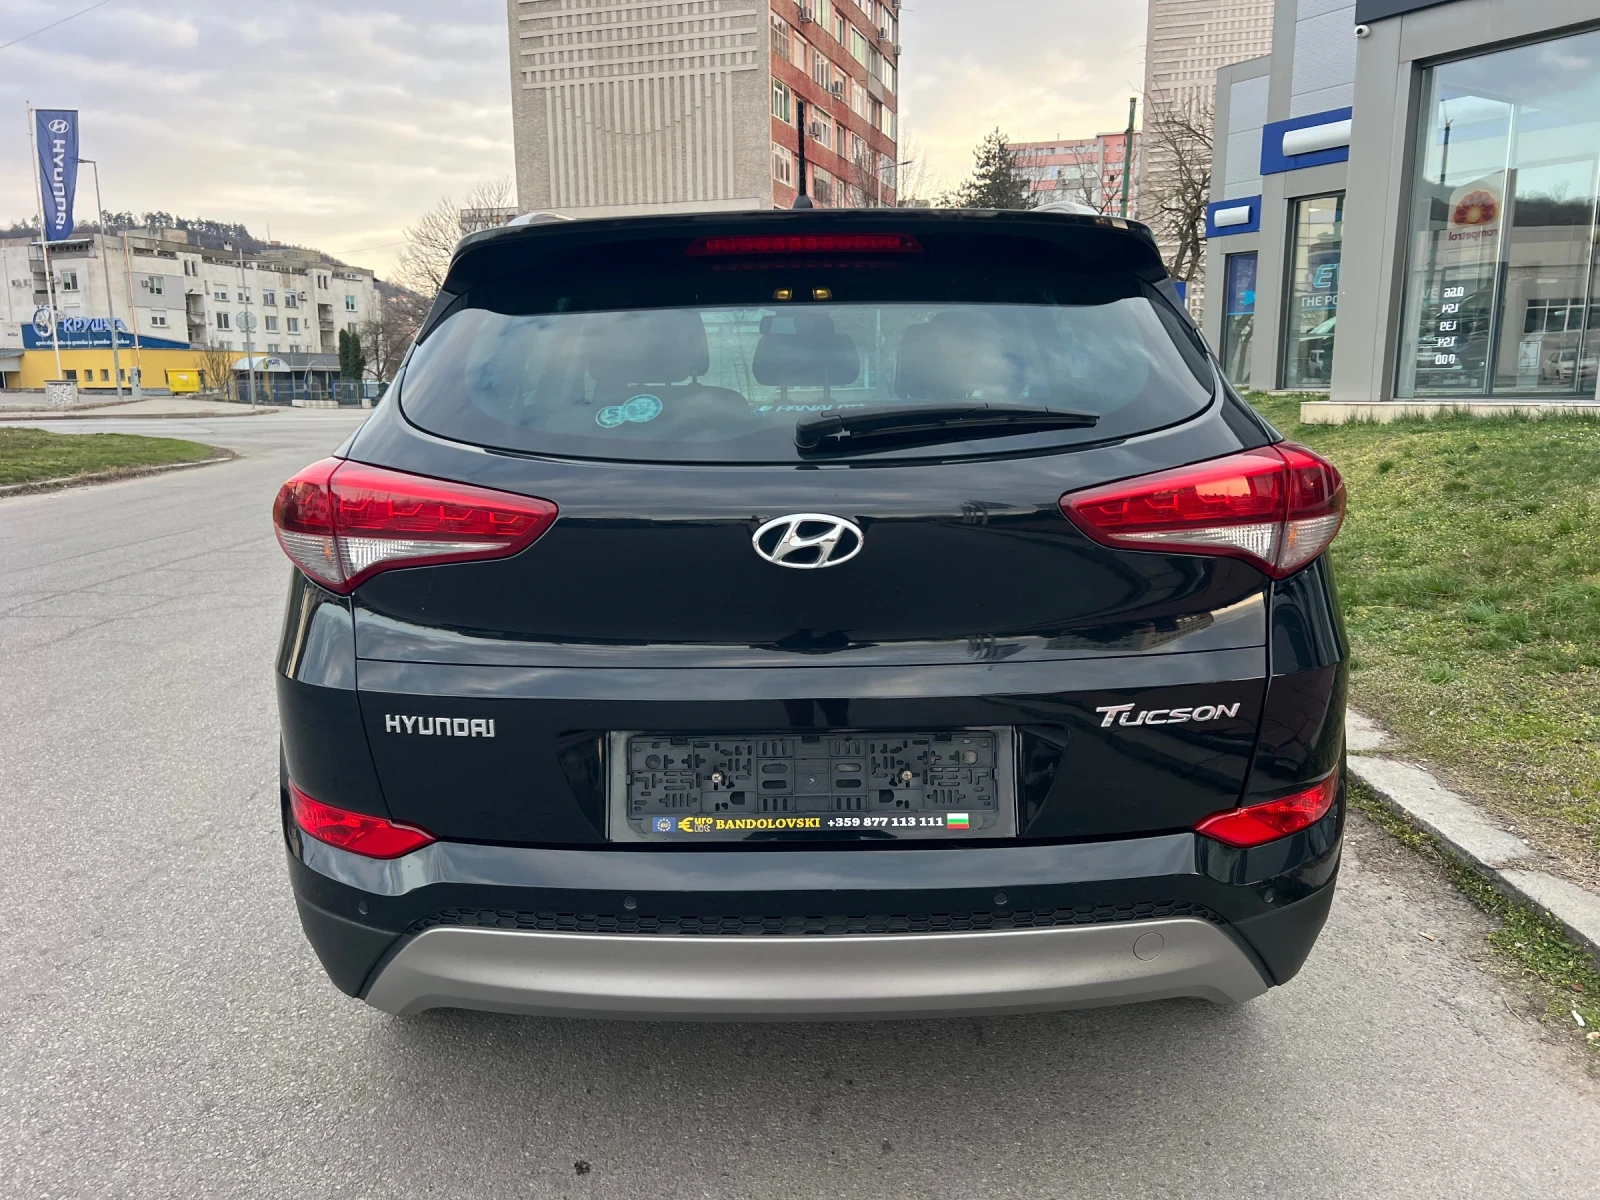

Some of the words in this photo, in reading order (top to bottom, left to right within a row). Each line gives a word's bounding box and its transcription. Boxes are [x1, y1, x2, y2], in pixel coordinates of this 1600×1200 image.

[53, 139, 67, 230] HYUNDAI
[1313, 263, 1341, 288] E
[1301, 296, 1322, 307] THE
[63, 317, 128, 333] КРУШАА
[384, 714, 496, 738] HYUNDAI
[715, 817, 821, 830] BANDOLOVSKI
[827, 816, 861, 828] +359
[862, 816, 889, 828] 877
[890, 816, 917, 828] 113
[918, 816, 945, 828] 111
